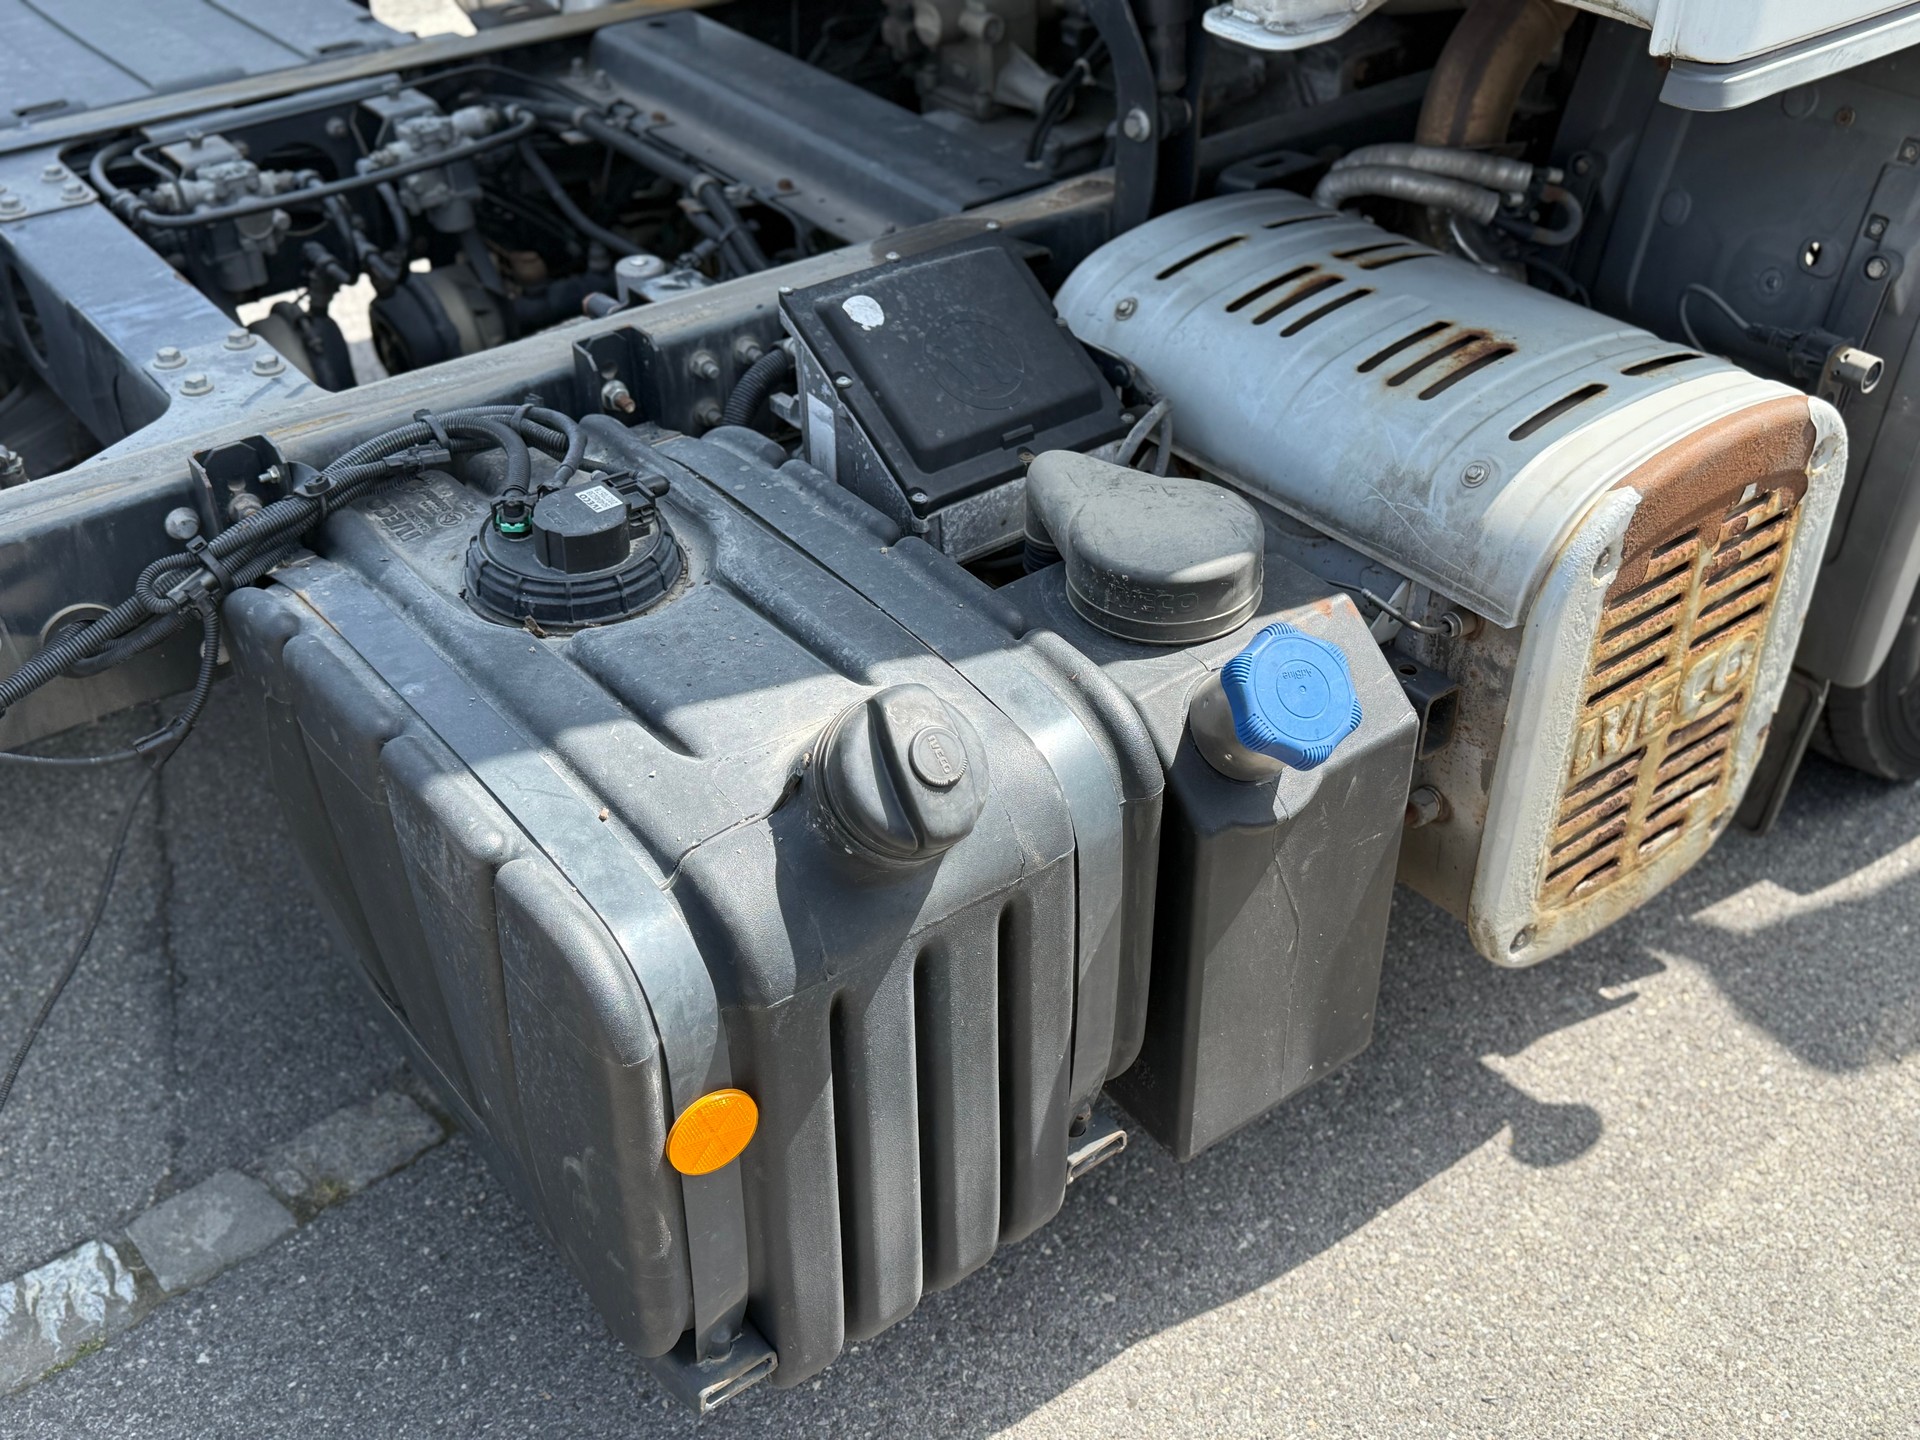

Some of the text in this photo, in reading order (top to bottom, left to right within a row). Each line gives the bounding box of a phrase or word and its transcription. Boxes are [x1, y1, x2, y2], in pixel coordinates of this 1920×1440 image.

[366, 500, 422, 542] IVECO
[1108, 584, 1199, 613] IVECO
[1571, 632, 1758, 777] IVECO
[928, 735, 952, 774] IVECO
